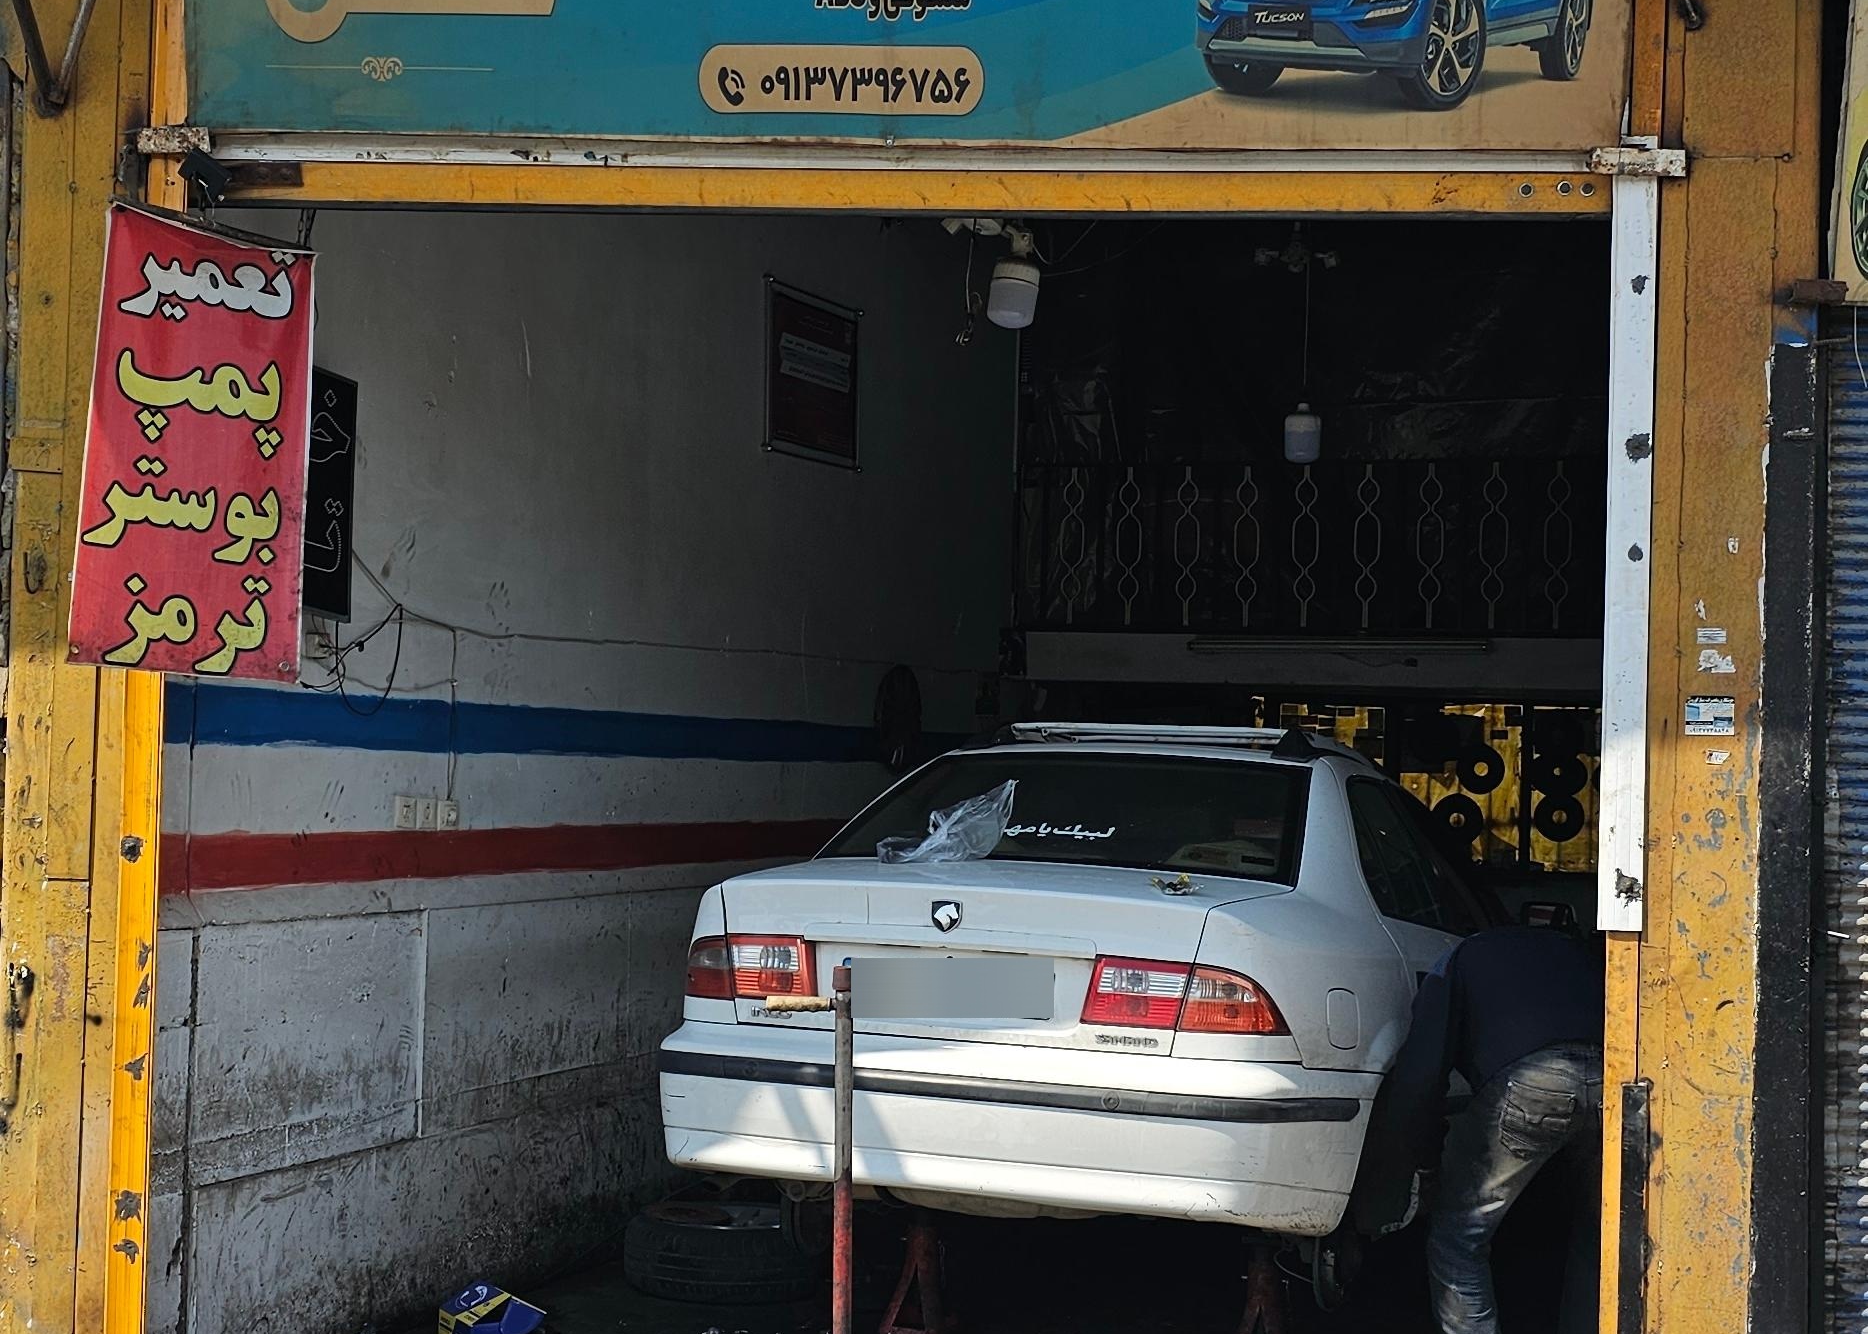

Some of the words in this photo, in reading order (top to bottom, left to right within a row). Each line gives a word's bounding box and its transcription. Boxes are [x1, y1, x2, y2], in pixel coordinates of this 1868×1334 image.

[1254, 11, 1304, 24] TUCSON
[761, 65, 971, 104] ۰۹۱۳۷۳۹۶۷۵۶
[118, 250, 300, 323] تعمیر
[116, 347, 285, 459] پمپ
[82, 457, 281, 565] بوستر
[102, 574, 272, 674] ترمز
